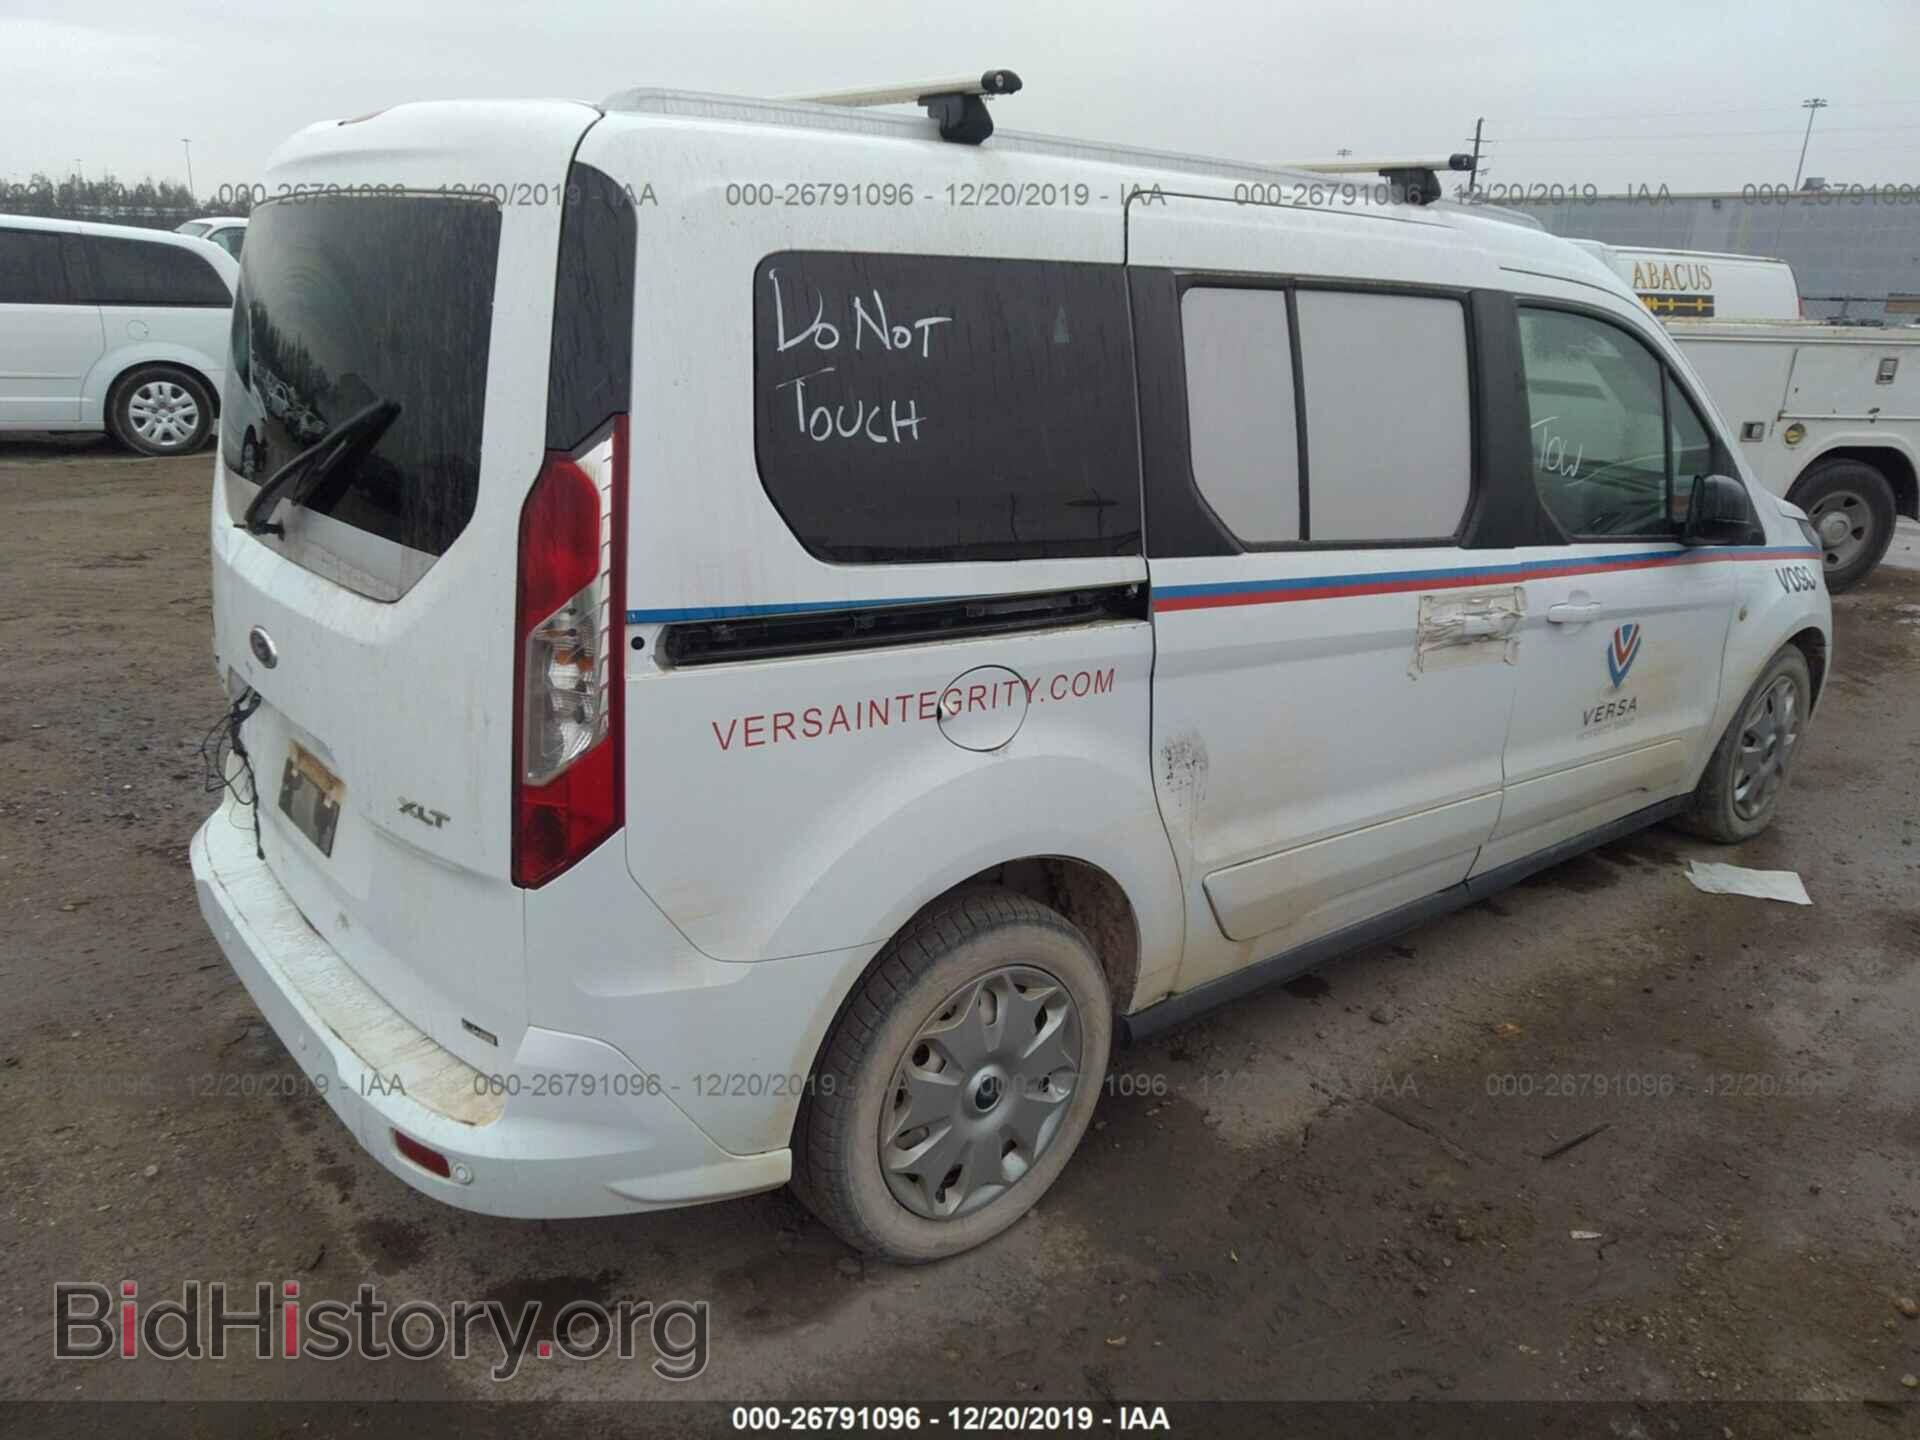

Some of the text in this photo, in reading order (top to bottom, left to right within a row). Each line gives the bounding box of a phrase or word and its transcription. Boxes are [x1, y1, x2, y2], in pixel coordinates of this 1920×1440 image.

[1632, 261, 1712, 291] ABACUS
[711, 667, 1116, 751] VERSAINTEGRITY.COM
[1583, 696, 1638, 726] VERSA
[397, 796, 451, 829] XLT
